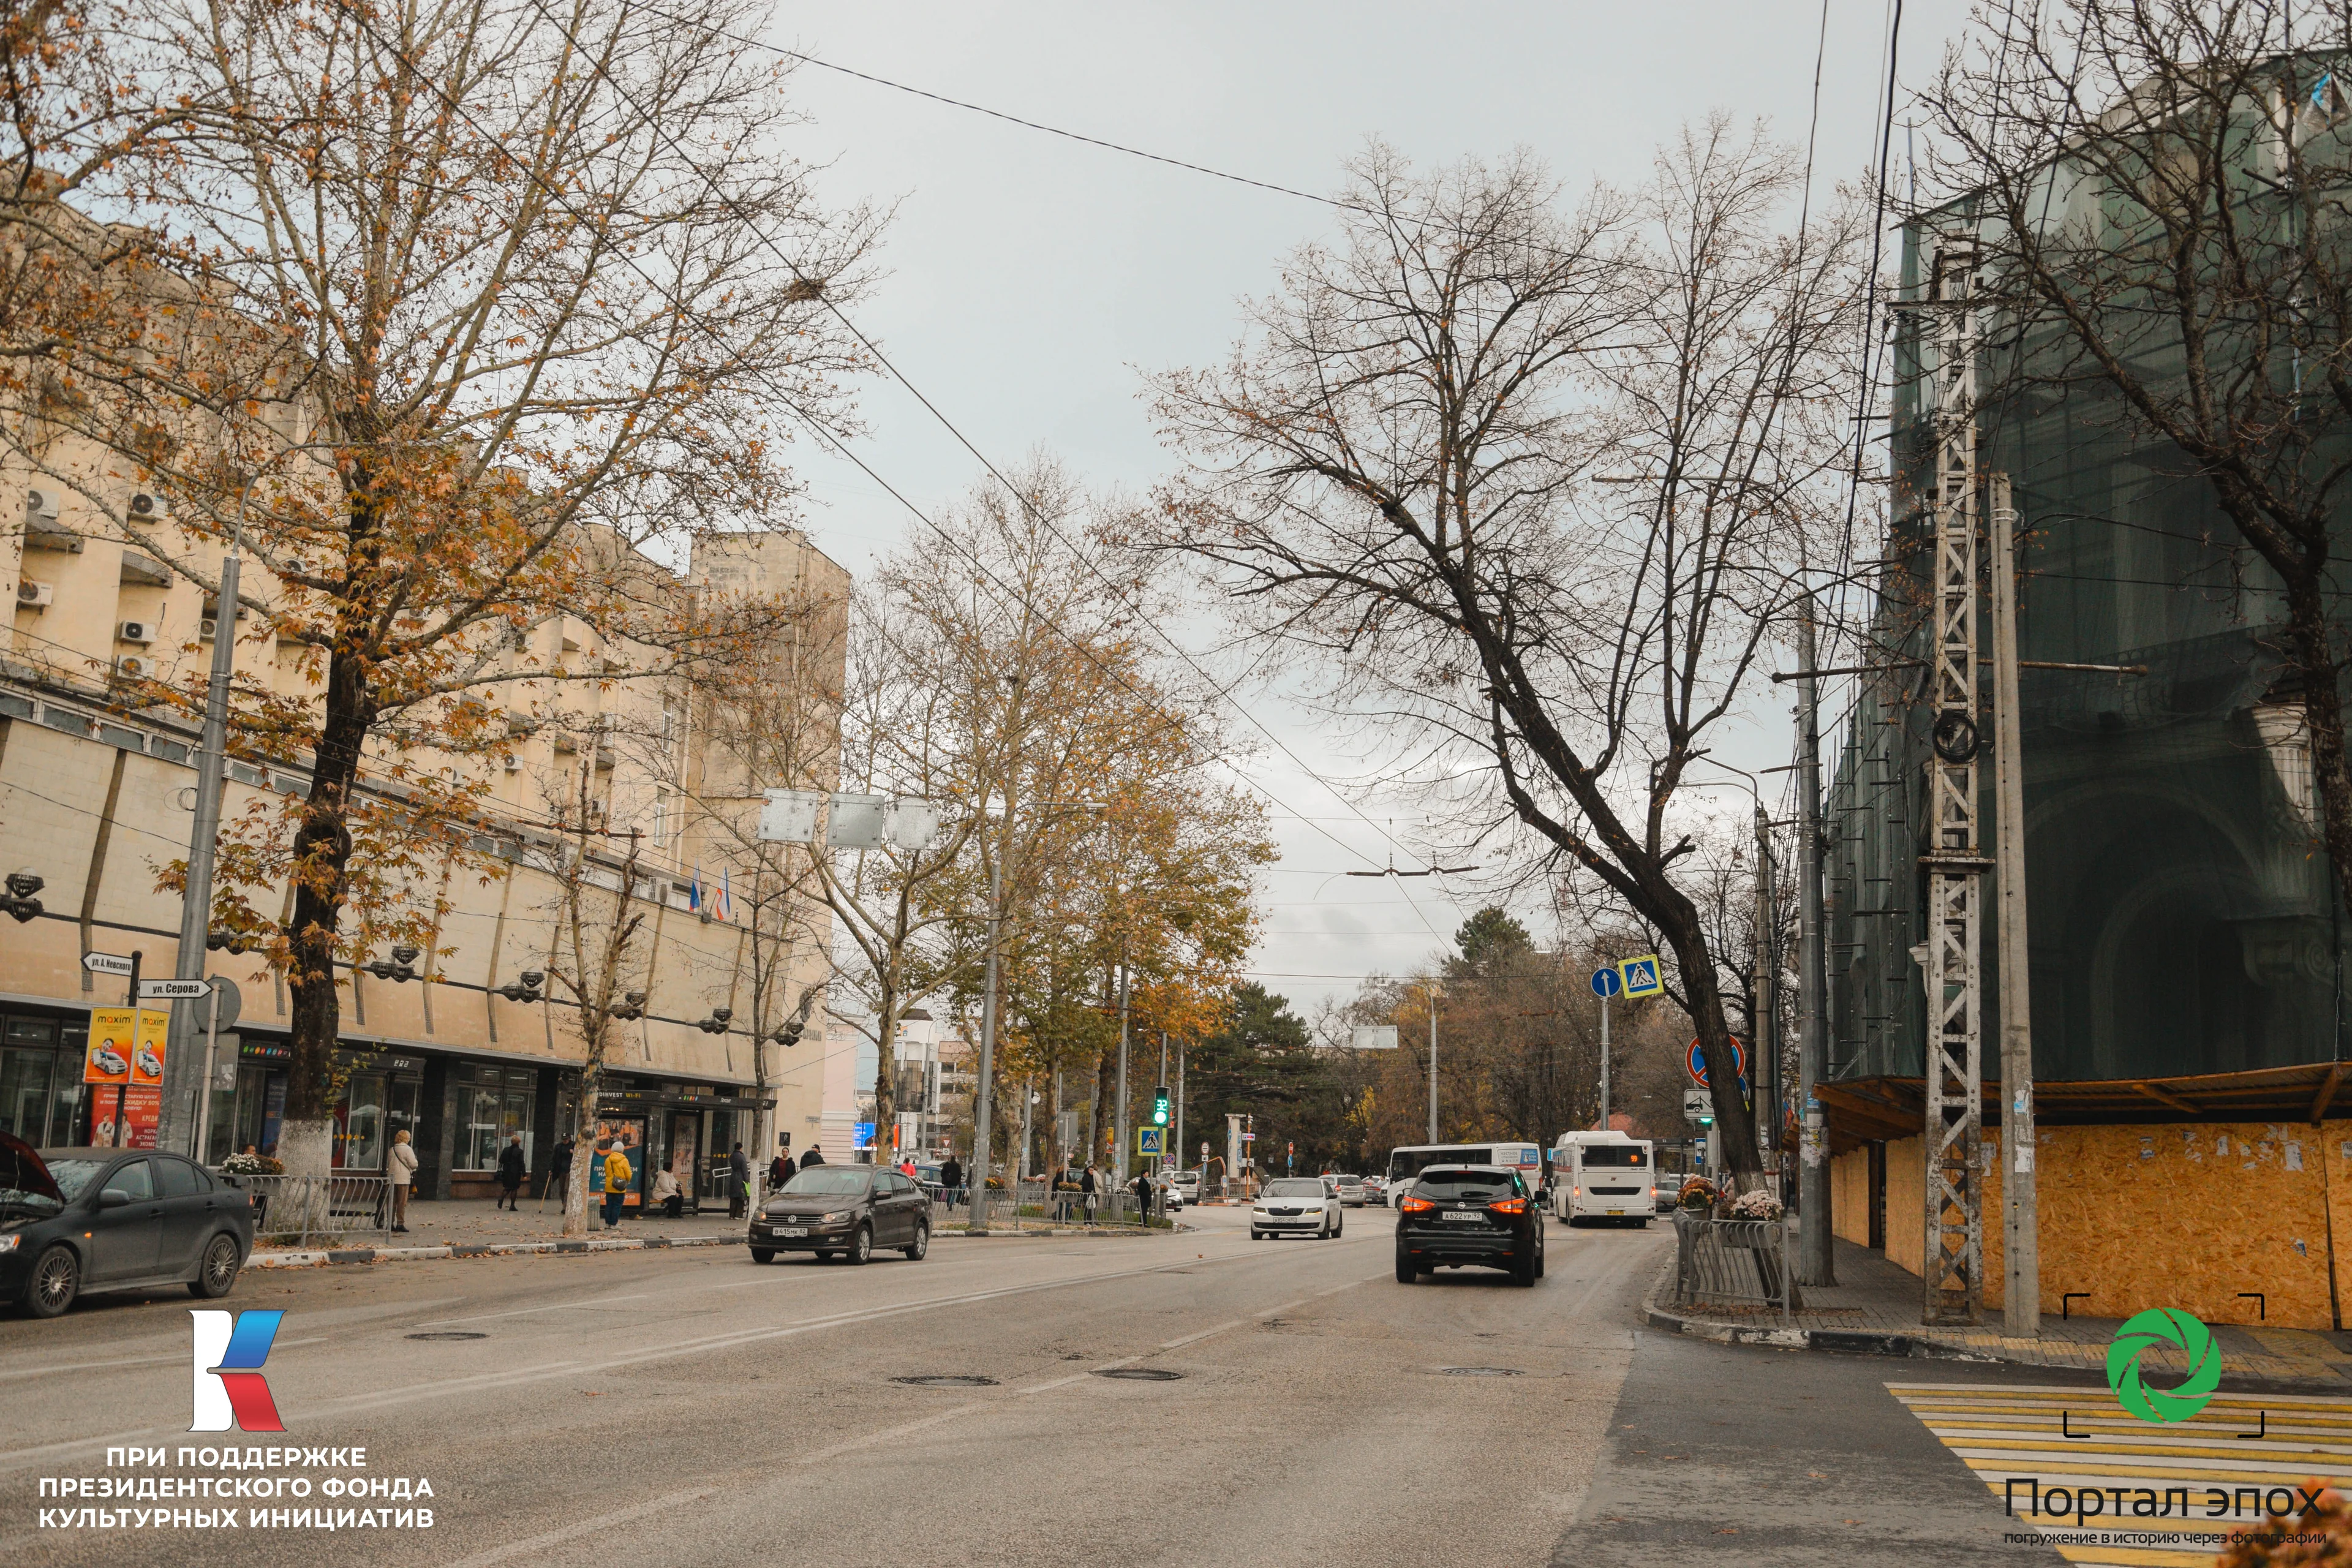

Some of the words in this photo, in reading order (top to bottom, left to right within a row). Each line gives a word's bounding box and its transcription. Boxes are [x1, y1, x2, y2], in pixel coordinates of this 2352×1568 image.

[100, 959, 105, 967] А.
[107, 960, 131, 971] Невского
[166, 983, 199, 994] Серова
[97, 1014, 130, 1023] maxim
[142, 1016, 165, 1027] maxim
[1157, 1099, 1167, 1110] 32
